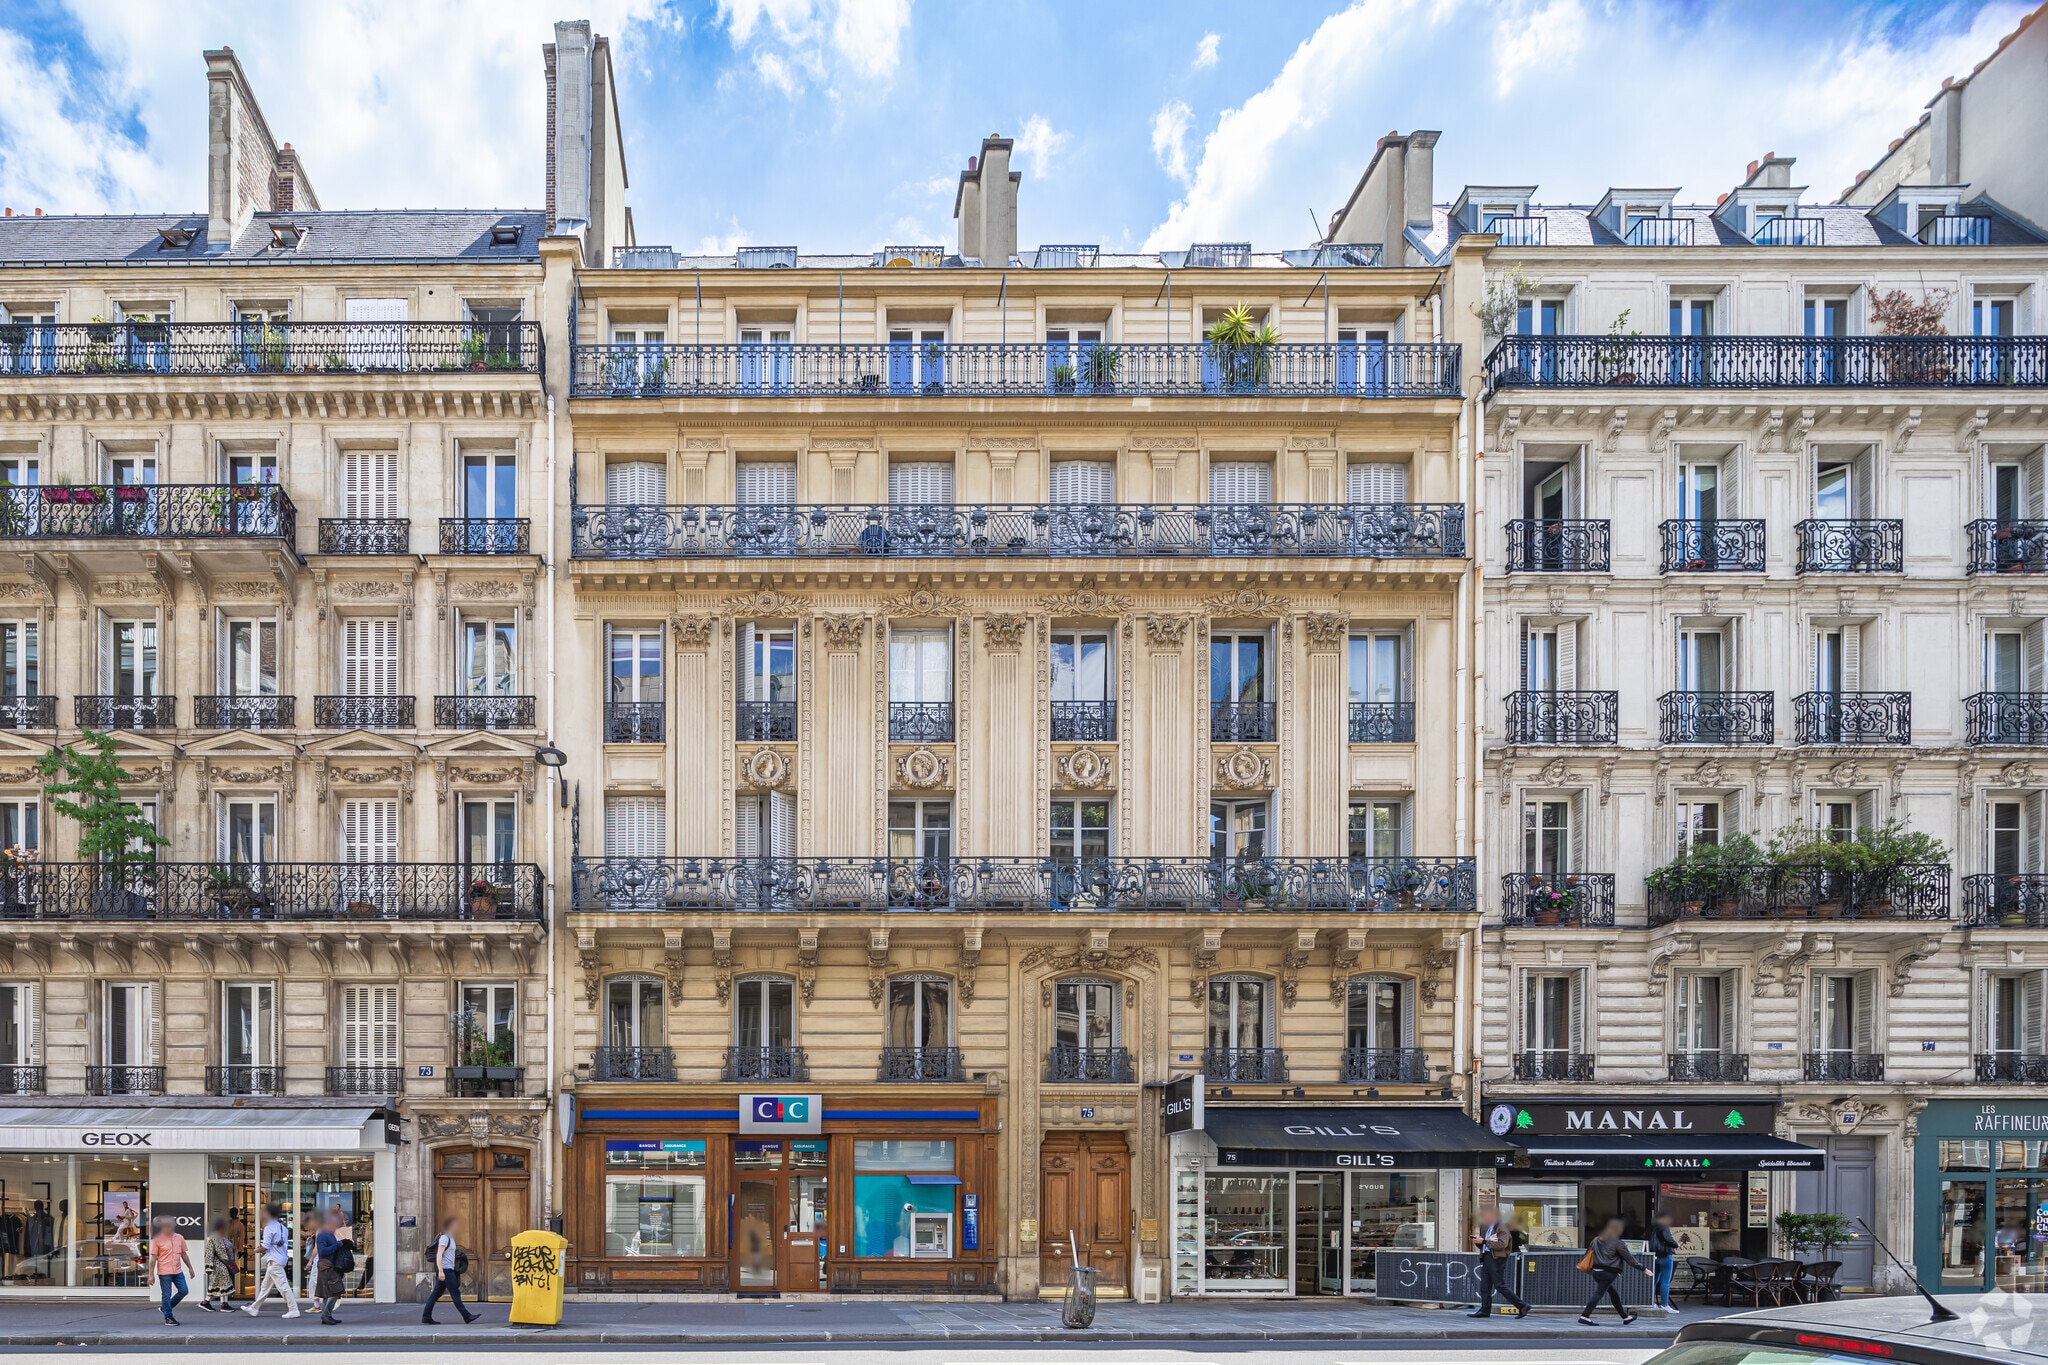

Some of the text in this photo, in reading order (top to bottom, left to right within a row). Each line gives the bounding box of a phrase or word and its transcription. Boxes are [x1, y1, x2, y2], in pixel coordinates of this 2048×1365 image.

[1923, 1041, 1935, 1050] 77
[420, 1067, 431, 1075] 73
[758, 1102, 804, 1119] CIC
[1167, 1098, 1191, 1115] GILL'S
[1981, 1105, 1995, 1114] LES
[1082, 1108, 1093, 1117] 75
[1565, 1110, 1693, 1130] MANAL
[1845, 1114, 1855, 1122] 77
[388, 1123, 400, 1132] GEOX
[1283, 1124, 1401, 1137] GILL'S
[82, 1132, 152, 1146] GEOX
[1336, 1154, 1395, 1166] GILL'S
[1655, 1159, 1700, 1168] MANAL
